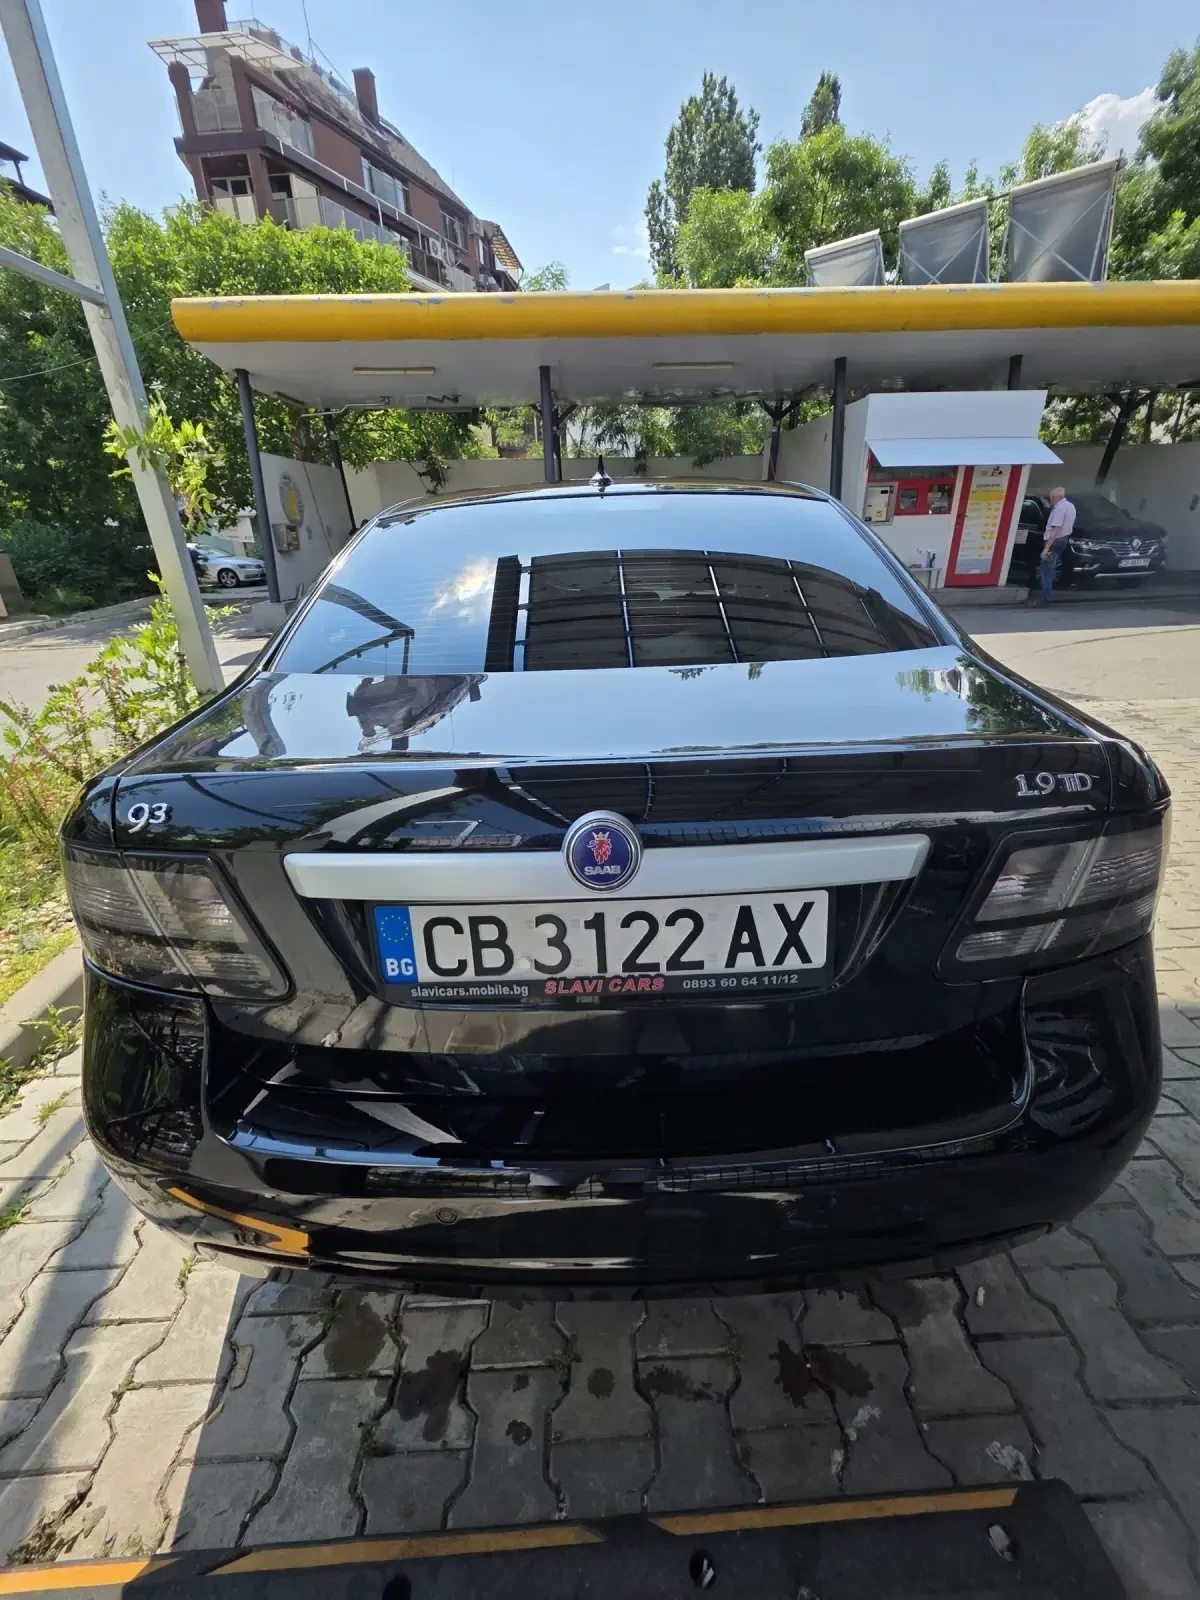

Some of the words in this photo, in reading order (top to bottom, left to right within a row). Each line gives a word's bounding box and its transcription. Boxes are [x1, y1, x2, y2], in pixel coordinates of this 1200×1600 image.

[1015, 772, 1055, 796] 1.9
[127, 802, 168, 834] 93
[583, 865, 621, 876] SAAB
[423, 915, 515, 977] CB
[534, 908, 705, 975] 3122
[724, 901, 815, 969] AX
[385, 957, 414, 977] BG
[544, 980, 604, 995] SLAVI
[608, 977, 665, 993] CARS
[682, 979, 717, 989] 0893
[720, 978, 737, 987] 60
[741, 976, 758, 987] 64
[762, 973, 799, 985] 11/12
[410, 984, 529, 998] slavicars.mobile.bg
